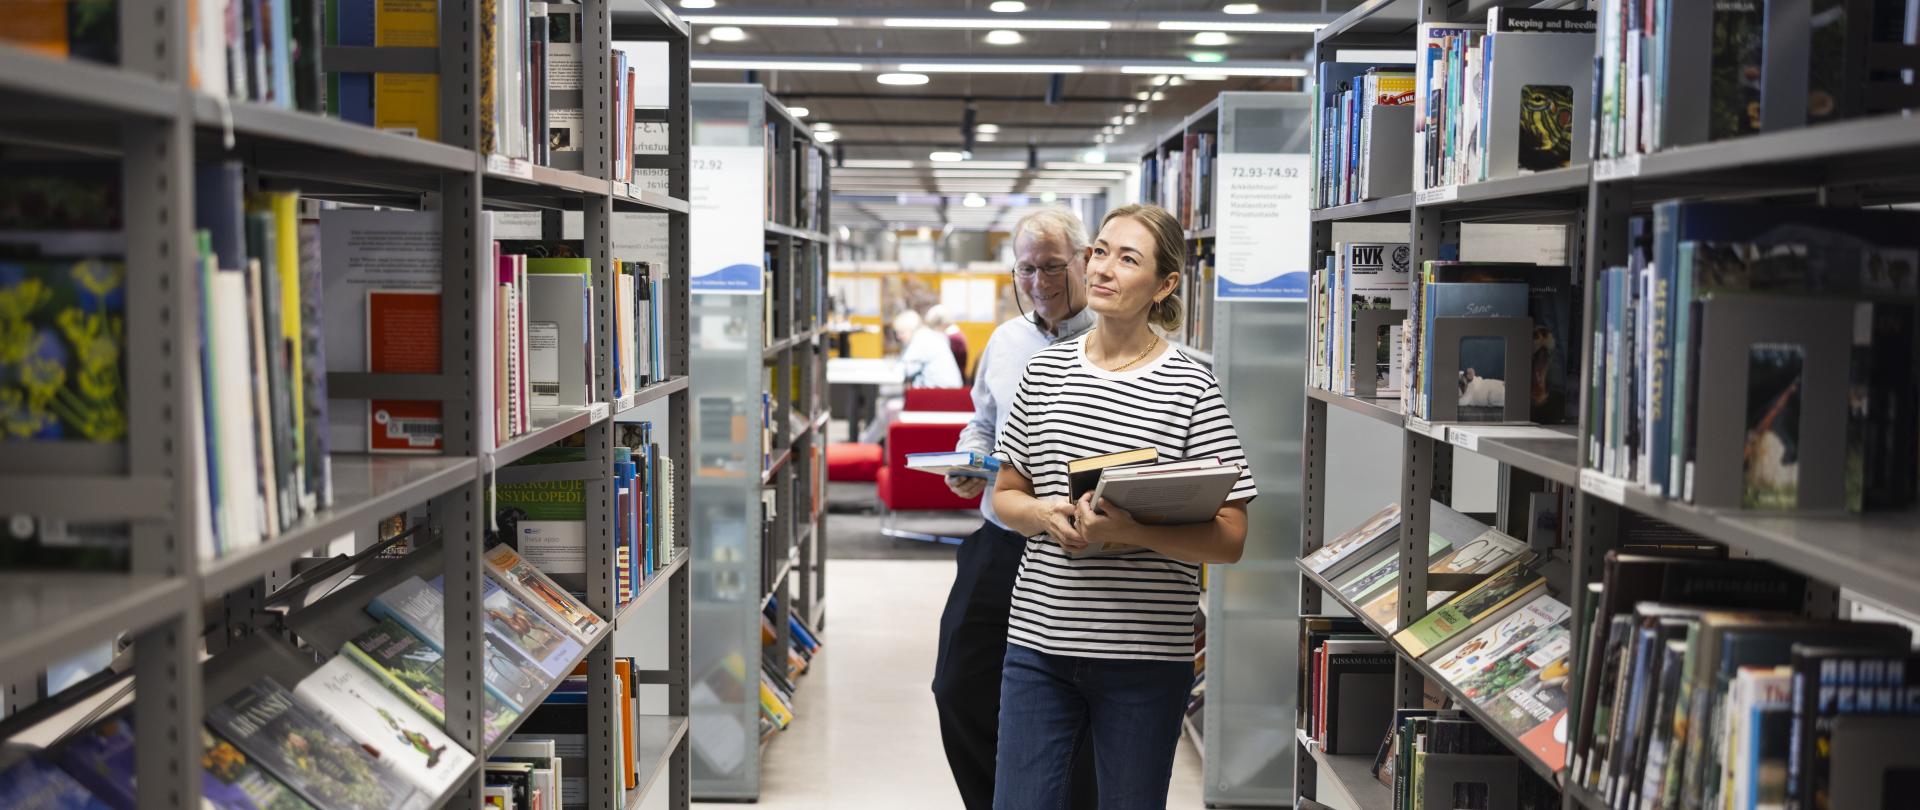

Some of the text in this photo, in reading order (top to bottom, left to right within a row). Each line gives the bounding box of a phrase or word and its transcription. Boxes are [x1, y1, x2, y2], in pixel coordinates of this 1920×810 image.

[1508, 18, 1543, 29] Keeping
[1545, 18, 1562, 28] and
[692, 160, 723, 170] 72.92
[1231, 167, 1298, 178] 72.93-74.92
[1352, 248, 1385, 265] HVK
[1652, 278, 1670, 421] METSÄSTYS
